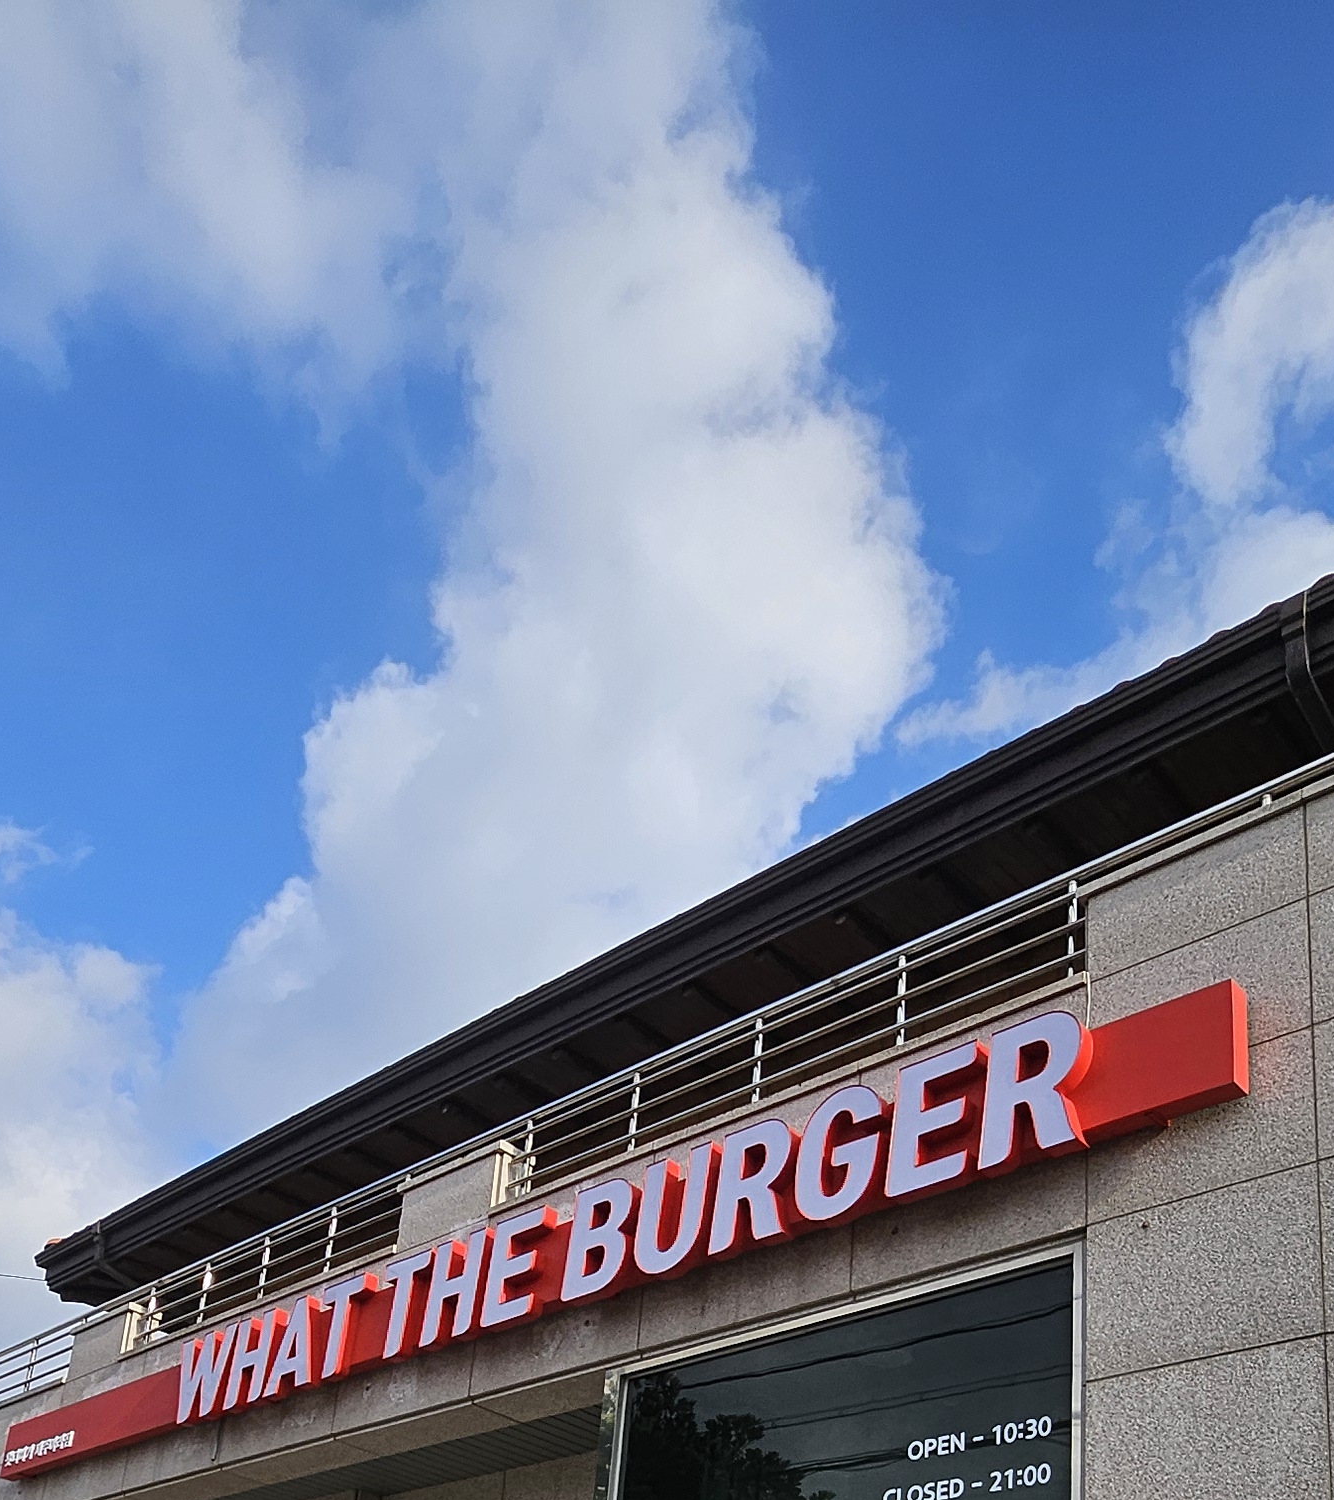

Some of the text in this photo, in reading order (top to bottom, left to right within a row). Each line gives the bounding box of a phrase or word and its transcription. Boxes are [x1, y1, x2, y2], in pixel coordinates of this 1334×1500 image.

[176, 1010, 1089, 1425] WHAT THE BURGER
[906, 1431, 966, 1461] OPEN
[992, 1415, 1053, 1446] 10:30
[988, 1463, 1053, 1493] 21:00
